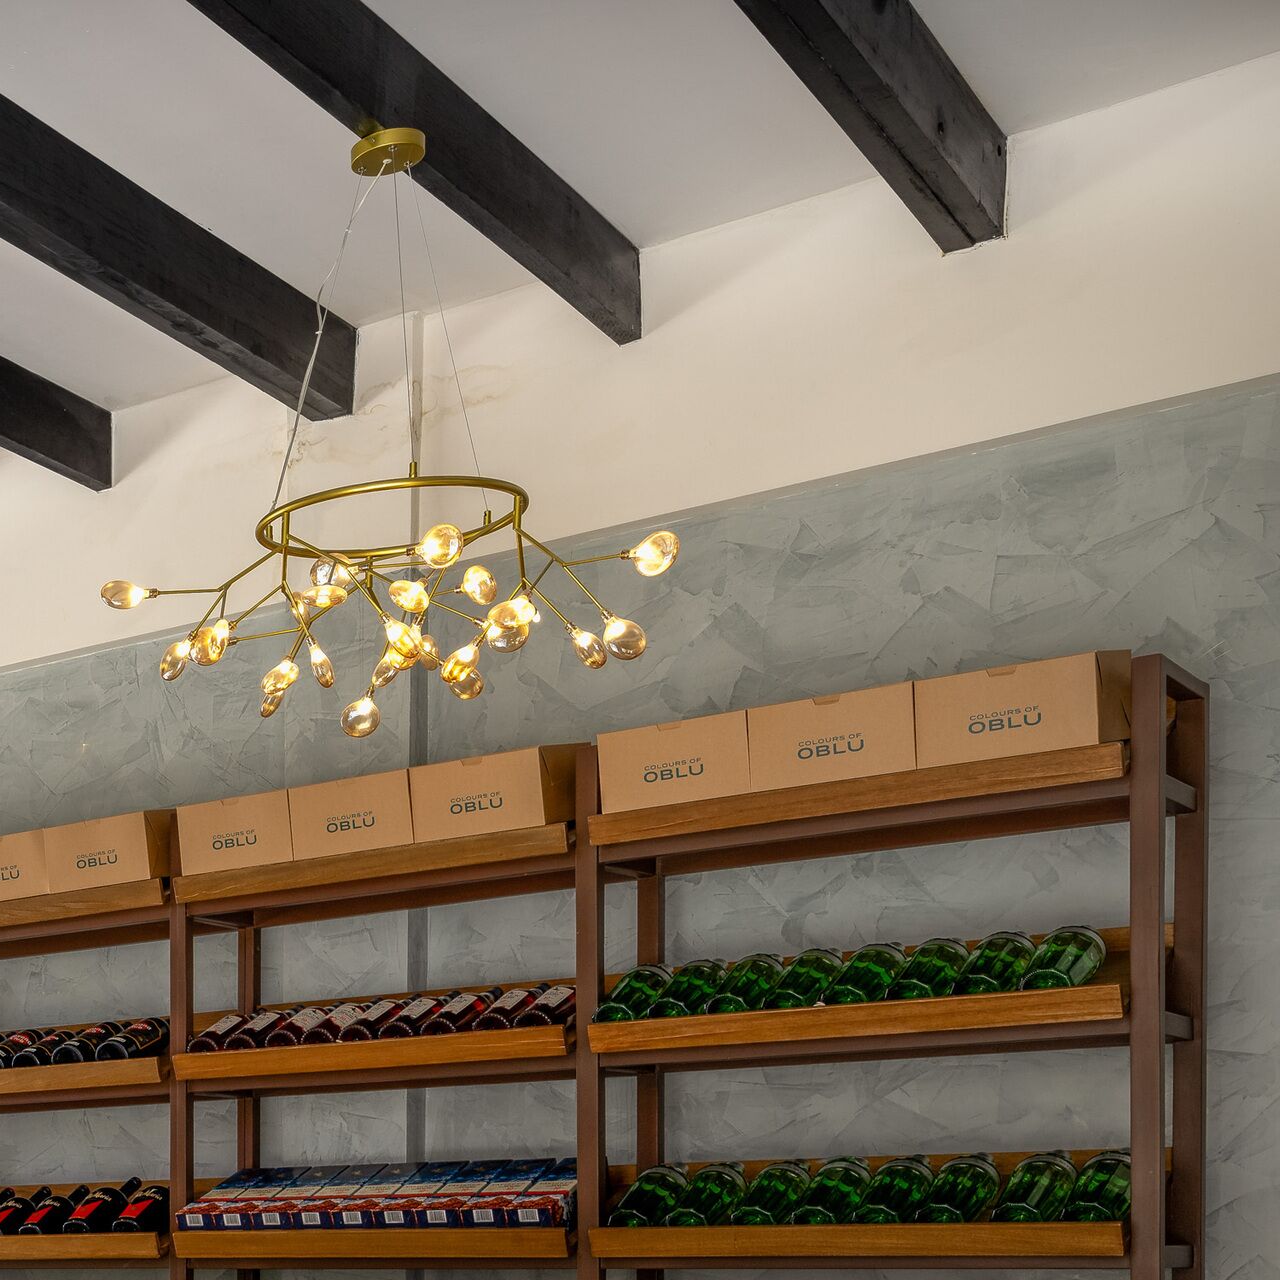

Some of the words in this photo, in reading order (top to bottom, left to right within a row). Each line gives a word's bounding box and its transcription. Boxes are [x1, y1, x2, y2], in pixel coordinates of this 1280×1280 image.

[969, 707, 1021, 721] COLOURS
[1024, 705, 1039, 715] OF
[968, 712, 1042, 734] OBLU
[798, 735, 847, 748] COLOURS
[848, 733, 862, 742] OF
[797, 739, 865, 760] OBLU
[644, 759, 688, 771] COLOURS
[689, 757, 702, 766] OF
[643, 763, 704, 783] OBLU
[450, 797, 503, 814] OBLU
[451, 793, 489, 803] COLOURS
[326, 813, 361, 823] COLOURS
[326, 816, 375, 833] OBLU
[212, 831, 244, 840] COLOURS
[212, 834, 257, 850] OBLU
[76, 850, 106, 859] COLOURS
[76, 854, 118, 869] OBLU
